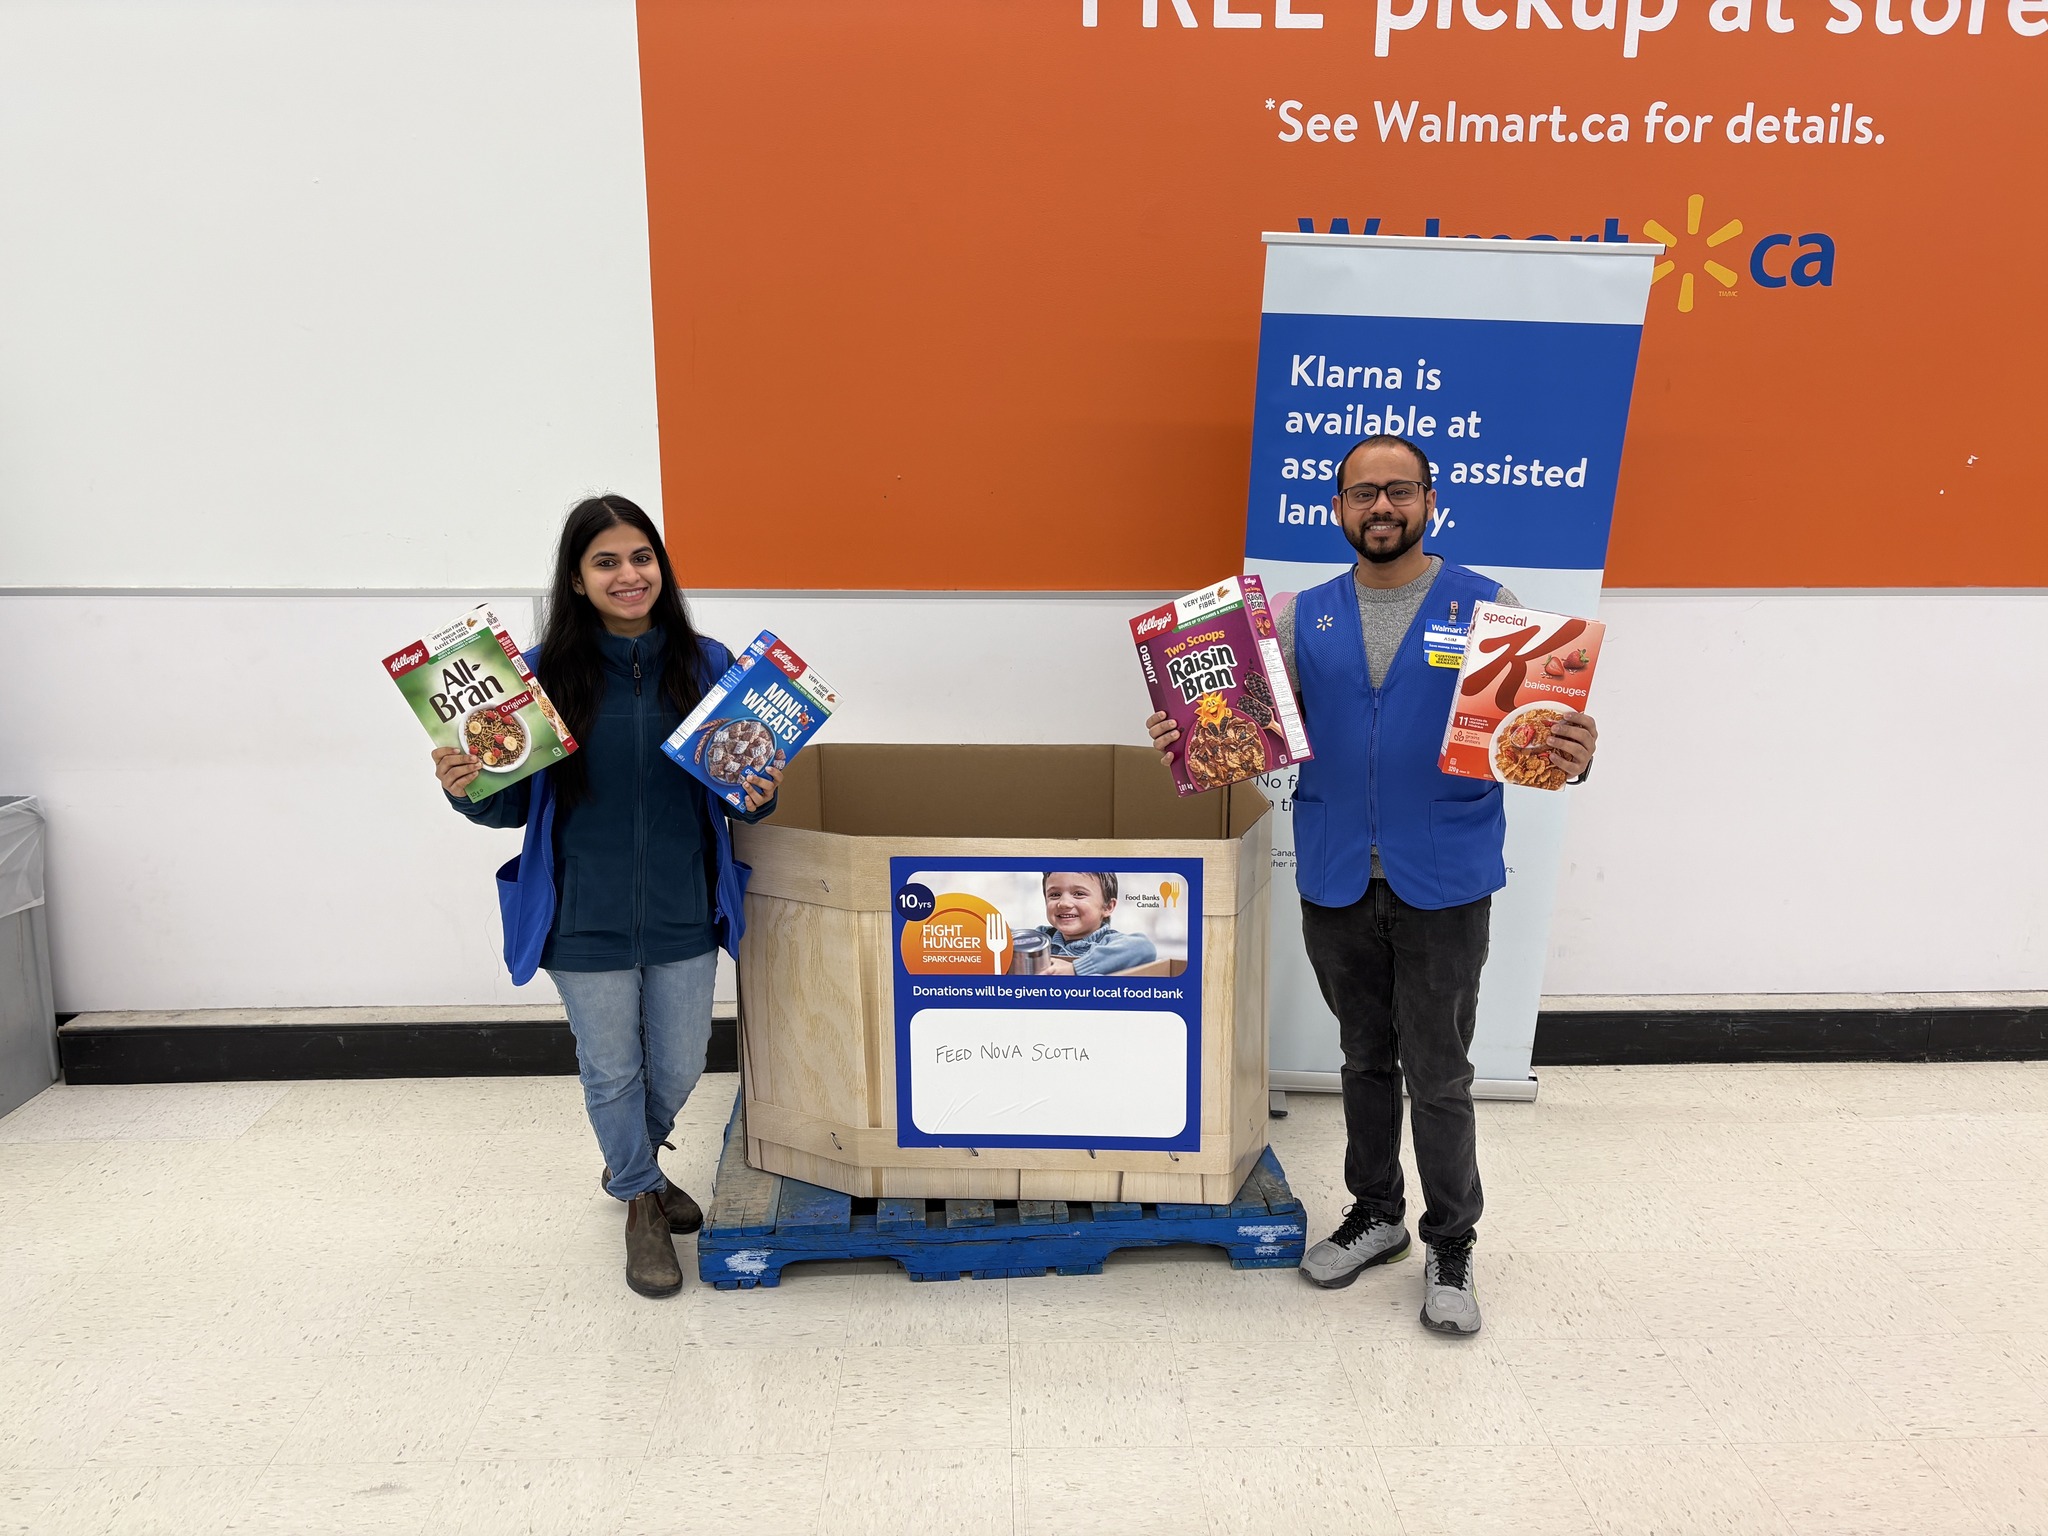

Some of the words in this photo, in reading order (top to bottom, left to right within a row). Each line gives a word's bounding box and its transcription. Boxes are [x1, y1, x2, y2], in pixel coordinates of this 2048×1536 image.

[1373, 100, 1630, 143] Walmart.ca
[1644, 100, 1713, 143] for
[1726, 101, 1885, 145] details.
[1749, 230, 1836, 289] ca
[1290, 354, 1403, 390] Klarna
[1416, 358, 1442, 391] is
[1285, 404, 1437, 437] available
[1447, 411, 1482, 439] at
[1450, 454, 1588, 488] assisted
[1182, 596, 1199, 609] VERY
[1199, 591, 1215, 602] HIGH
[1198, 598, 1217, 610] FIBRE
[1136, 612, 1173, 635] Kellogg's
[1431, 624, 1463, 634] Walmart
[1483, 612, 1528, 628] special
[1163, 641, 1186, 658] Two
[1186, 629, 1226, 647] Scoops
[390, 648, 424, 673] Kellogg's
[771, 648, 800, 673] Kellogg's
[1139, 645, 1158, 685] JUMBO
[1167, 645, 1236, 687] Raisin
[1180, 666, 1235, 703] Bran
[1524, 679, 1551, 692] baies
[1552, 684, 1587, 697] rouges
[428, 673, 505, 724] Bran
[500, 694, 530, 714] Original
[741, 688, 803, 745] WHEATS!
[1125, 893, 1141, 901] Food
[922, 924, 963, 937] FIGHT
[922, 936, 981, 949] HUNGER
[922, 955, 948, 963] SPARK
[948, 955, 982, 963] CHANGE
[912, 984, 974, 997] Donations
[975, 985, 995, 997] will
[997, 985, 1013, 997] be
[1014, 986, 1048, 999] given
[1049, 987, 1062, 997] to
[1063, 988, 1091, 999] your
[1092, 987, 1122, 998] local
[1123, 987, 1152, 998] food
[1153, 987, 1184, 999] bank
[936, 1044, 973, 1064] FEED
[980, 1042, 1023, 1060] NOVA
[1031, 1043, 1090, 1062] SCOTIA
